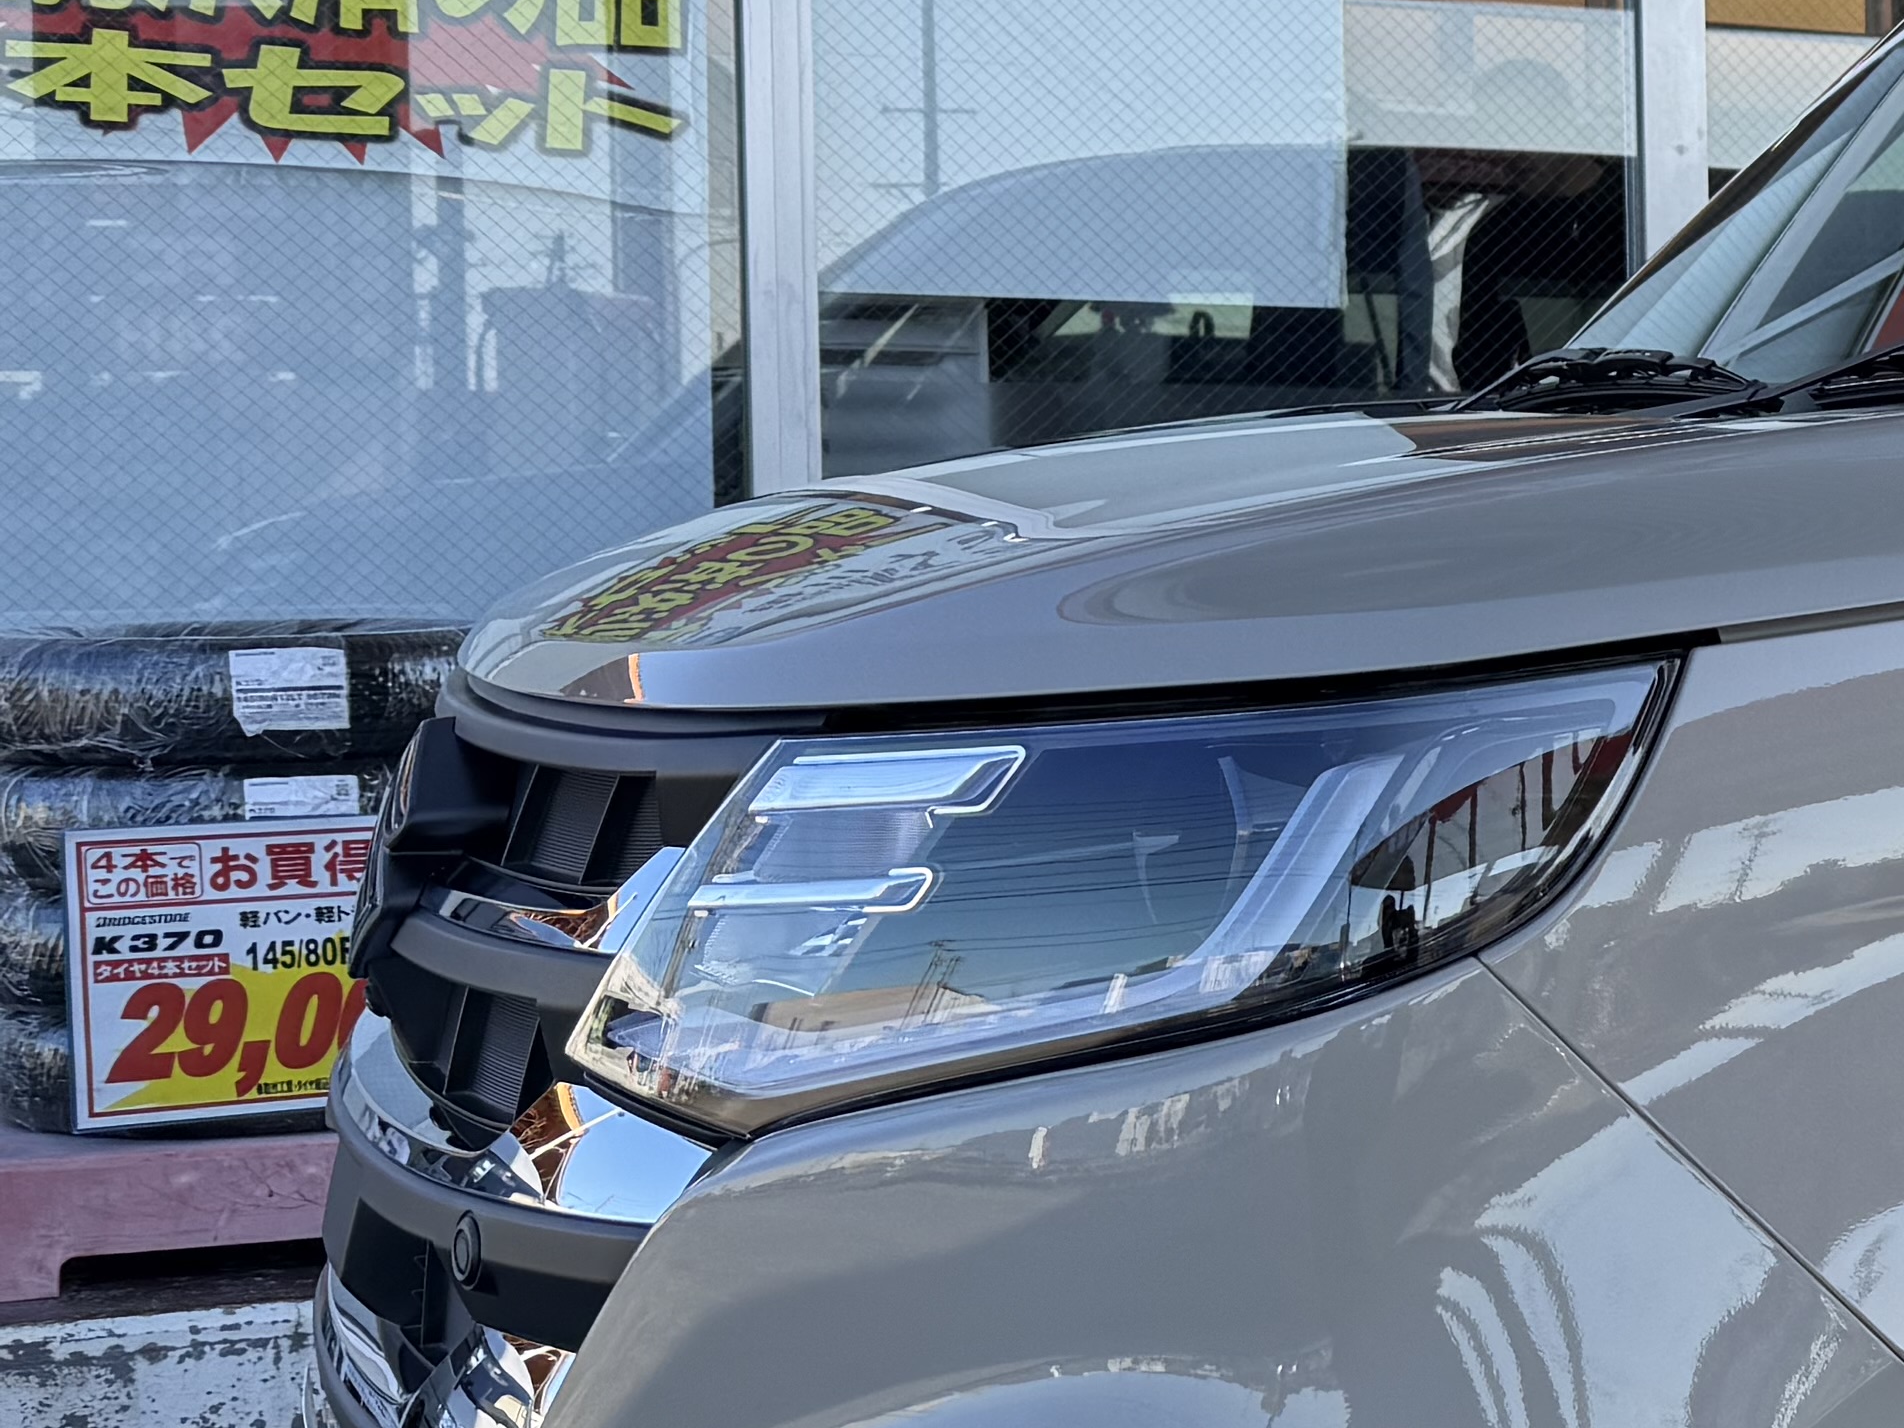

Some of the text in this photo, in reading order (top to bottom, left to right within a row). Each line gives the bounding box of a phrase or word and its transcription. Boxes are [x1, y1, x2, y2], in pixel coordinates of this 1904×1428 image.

[90, 848, 196, 874] 4本で
[92, 872, 197, 899] この価格
[95, 912, 191, 929] BRIDGESTONE
[239, 904, 355, 929] 軽バン・軽ト
[91, 929, 224, 956] K370
[95, 960, 227, 981] タイヤ4本セット
